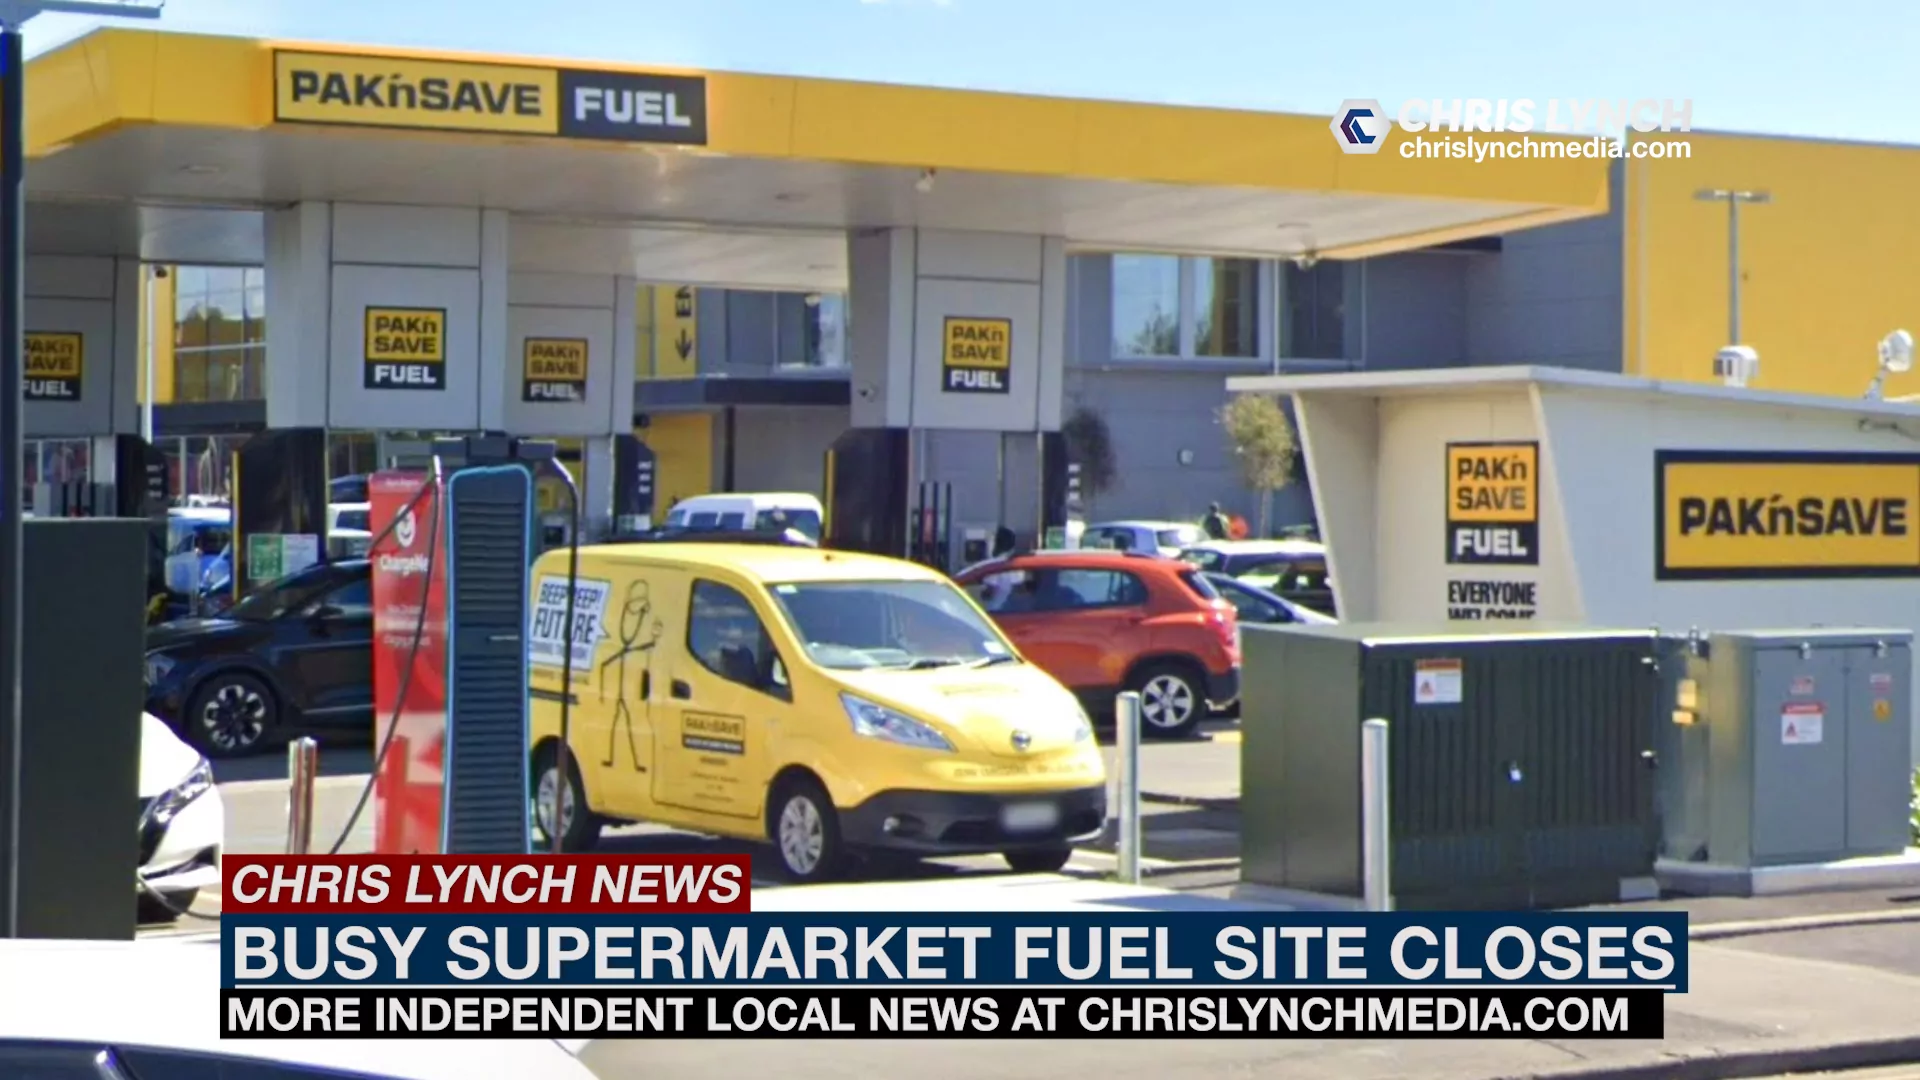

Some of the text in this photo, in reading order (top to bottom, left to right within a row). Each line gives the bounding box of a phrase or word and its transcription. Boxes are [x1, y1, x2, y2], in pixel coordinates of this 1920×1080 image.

[574, 86, 691, 127] FUEL
[374, 335, 437, 354] SAVE
[951, 343, 1003, 361] SAVE
[374, 363, 437, 384] FUEL
[530, 360, 580, 375] SAVE
[950, 369, 1003, 389] FUEL
[529, 382, 581, 399] FUEL
[1456, 486, 1527, 511] SAVE
[1455, 528, 1528, 557] FUEL
[1447, 580, 1536, 606] EVERYONE
[533, 606, 597, 644] FUTRE
